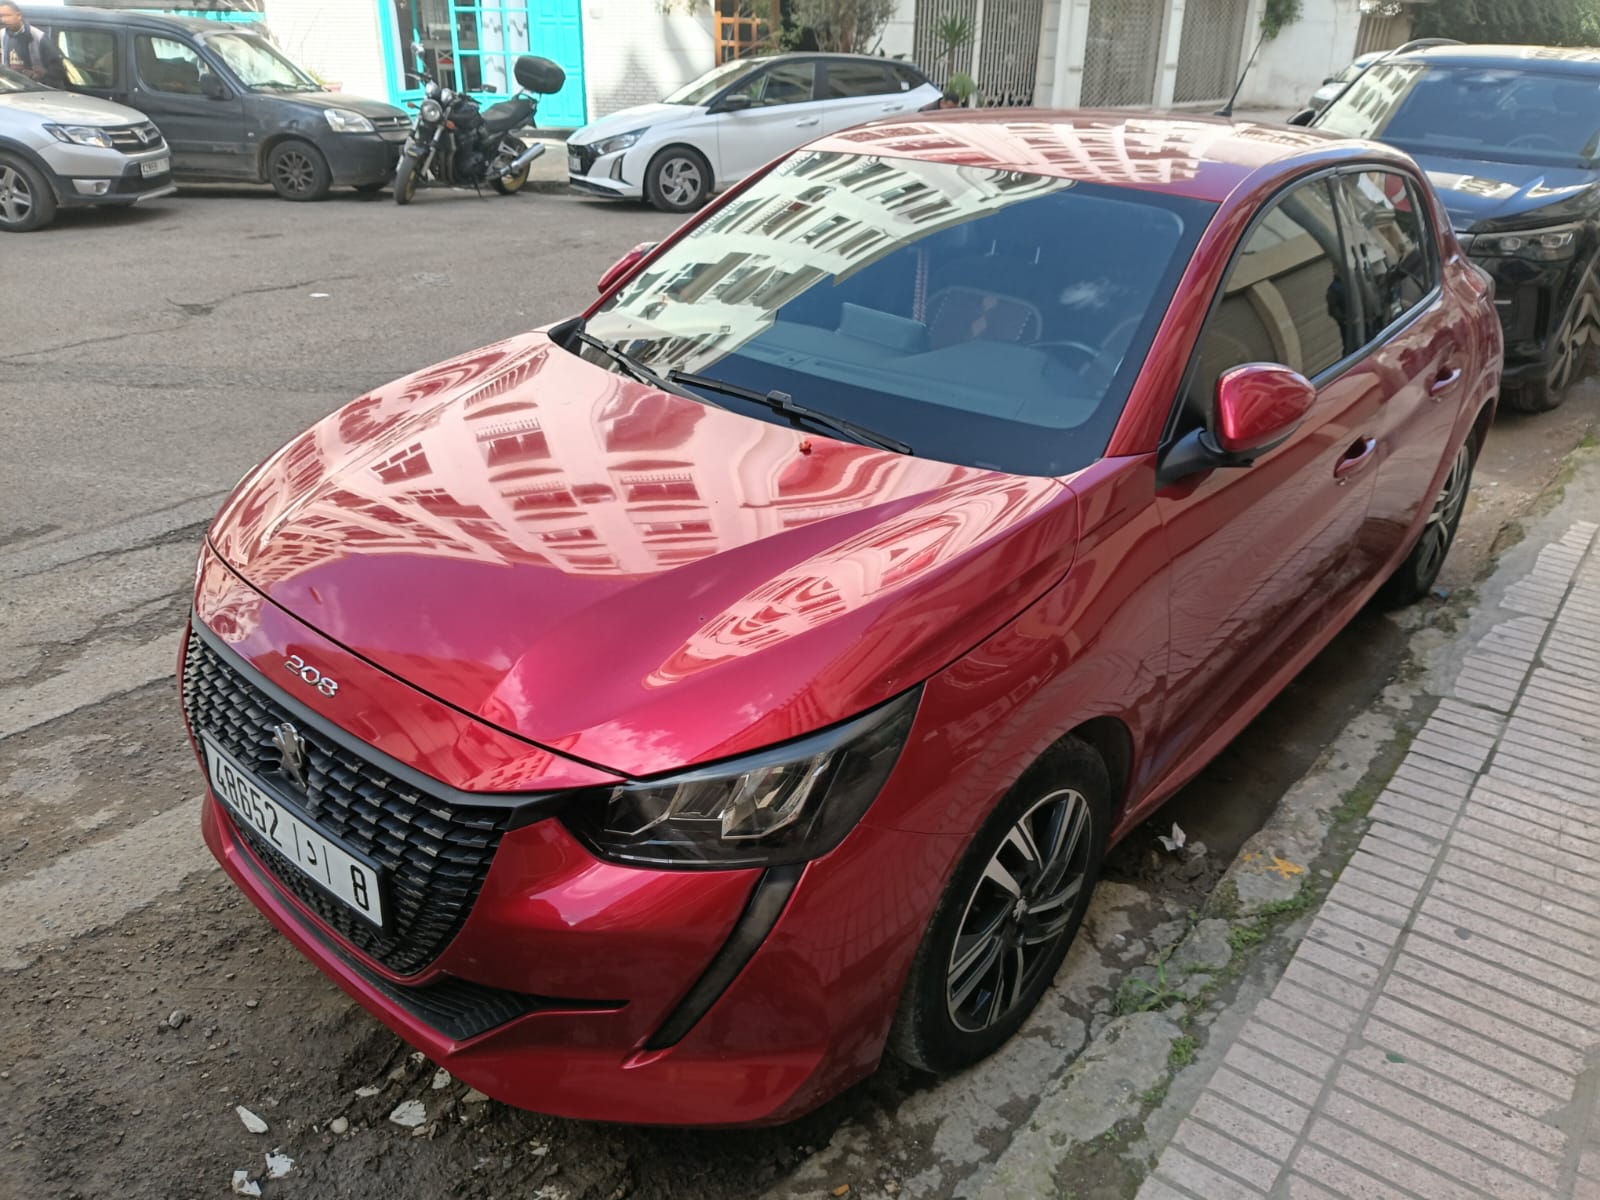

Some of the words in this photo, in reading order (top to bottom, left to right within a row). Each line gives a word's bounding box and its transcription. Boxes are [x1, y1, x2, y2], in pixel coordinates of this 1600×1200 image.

[284, 654, 338, 698] 208
[216, 757, 283, 848] 48652
[350, 864, 370, 912] 8
